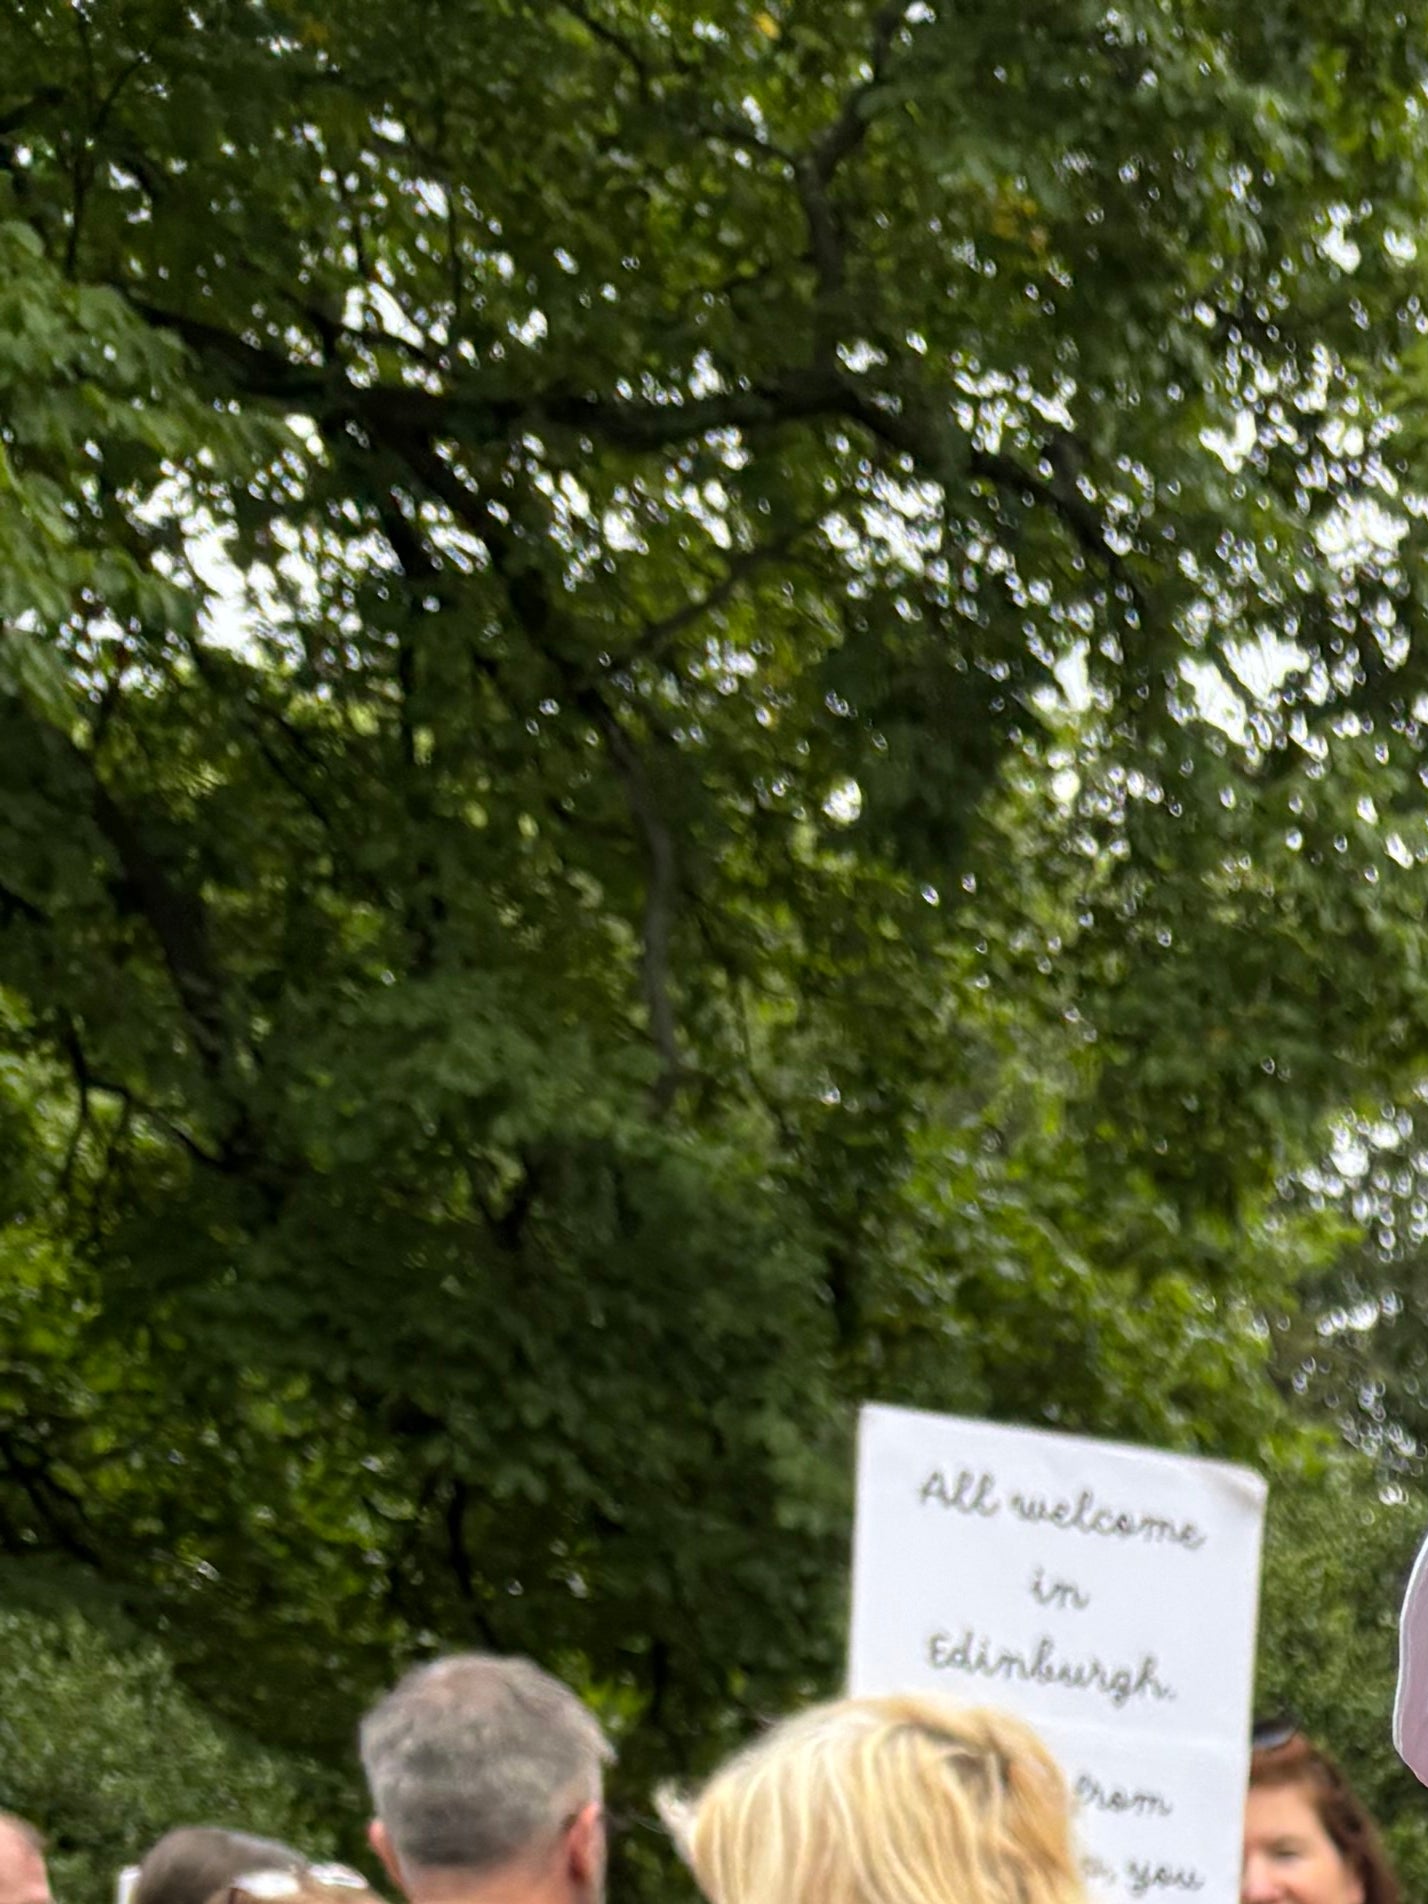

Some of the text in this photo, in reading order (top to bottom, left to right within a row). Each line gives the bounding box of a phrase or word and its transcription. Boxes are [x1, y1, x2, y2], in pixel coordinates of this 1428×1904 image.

[917, 1470, 1206, 1551] All welcome
[1030, 1566, 1090, 1611] in
[1125, 1861, 1205, 1898] you
